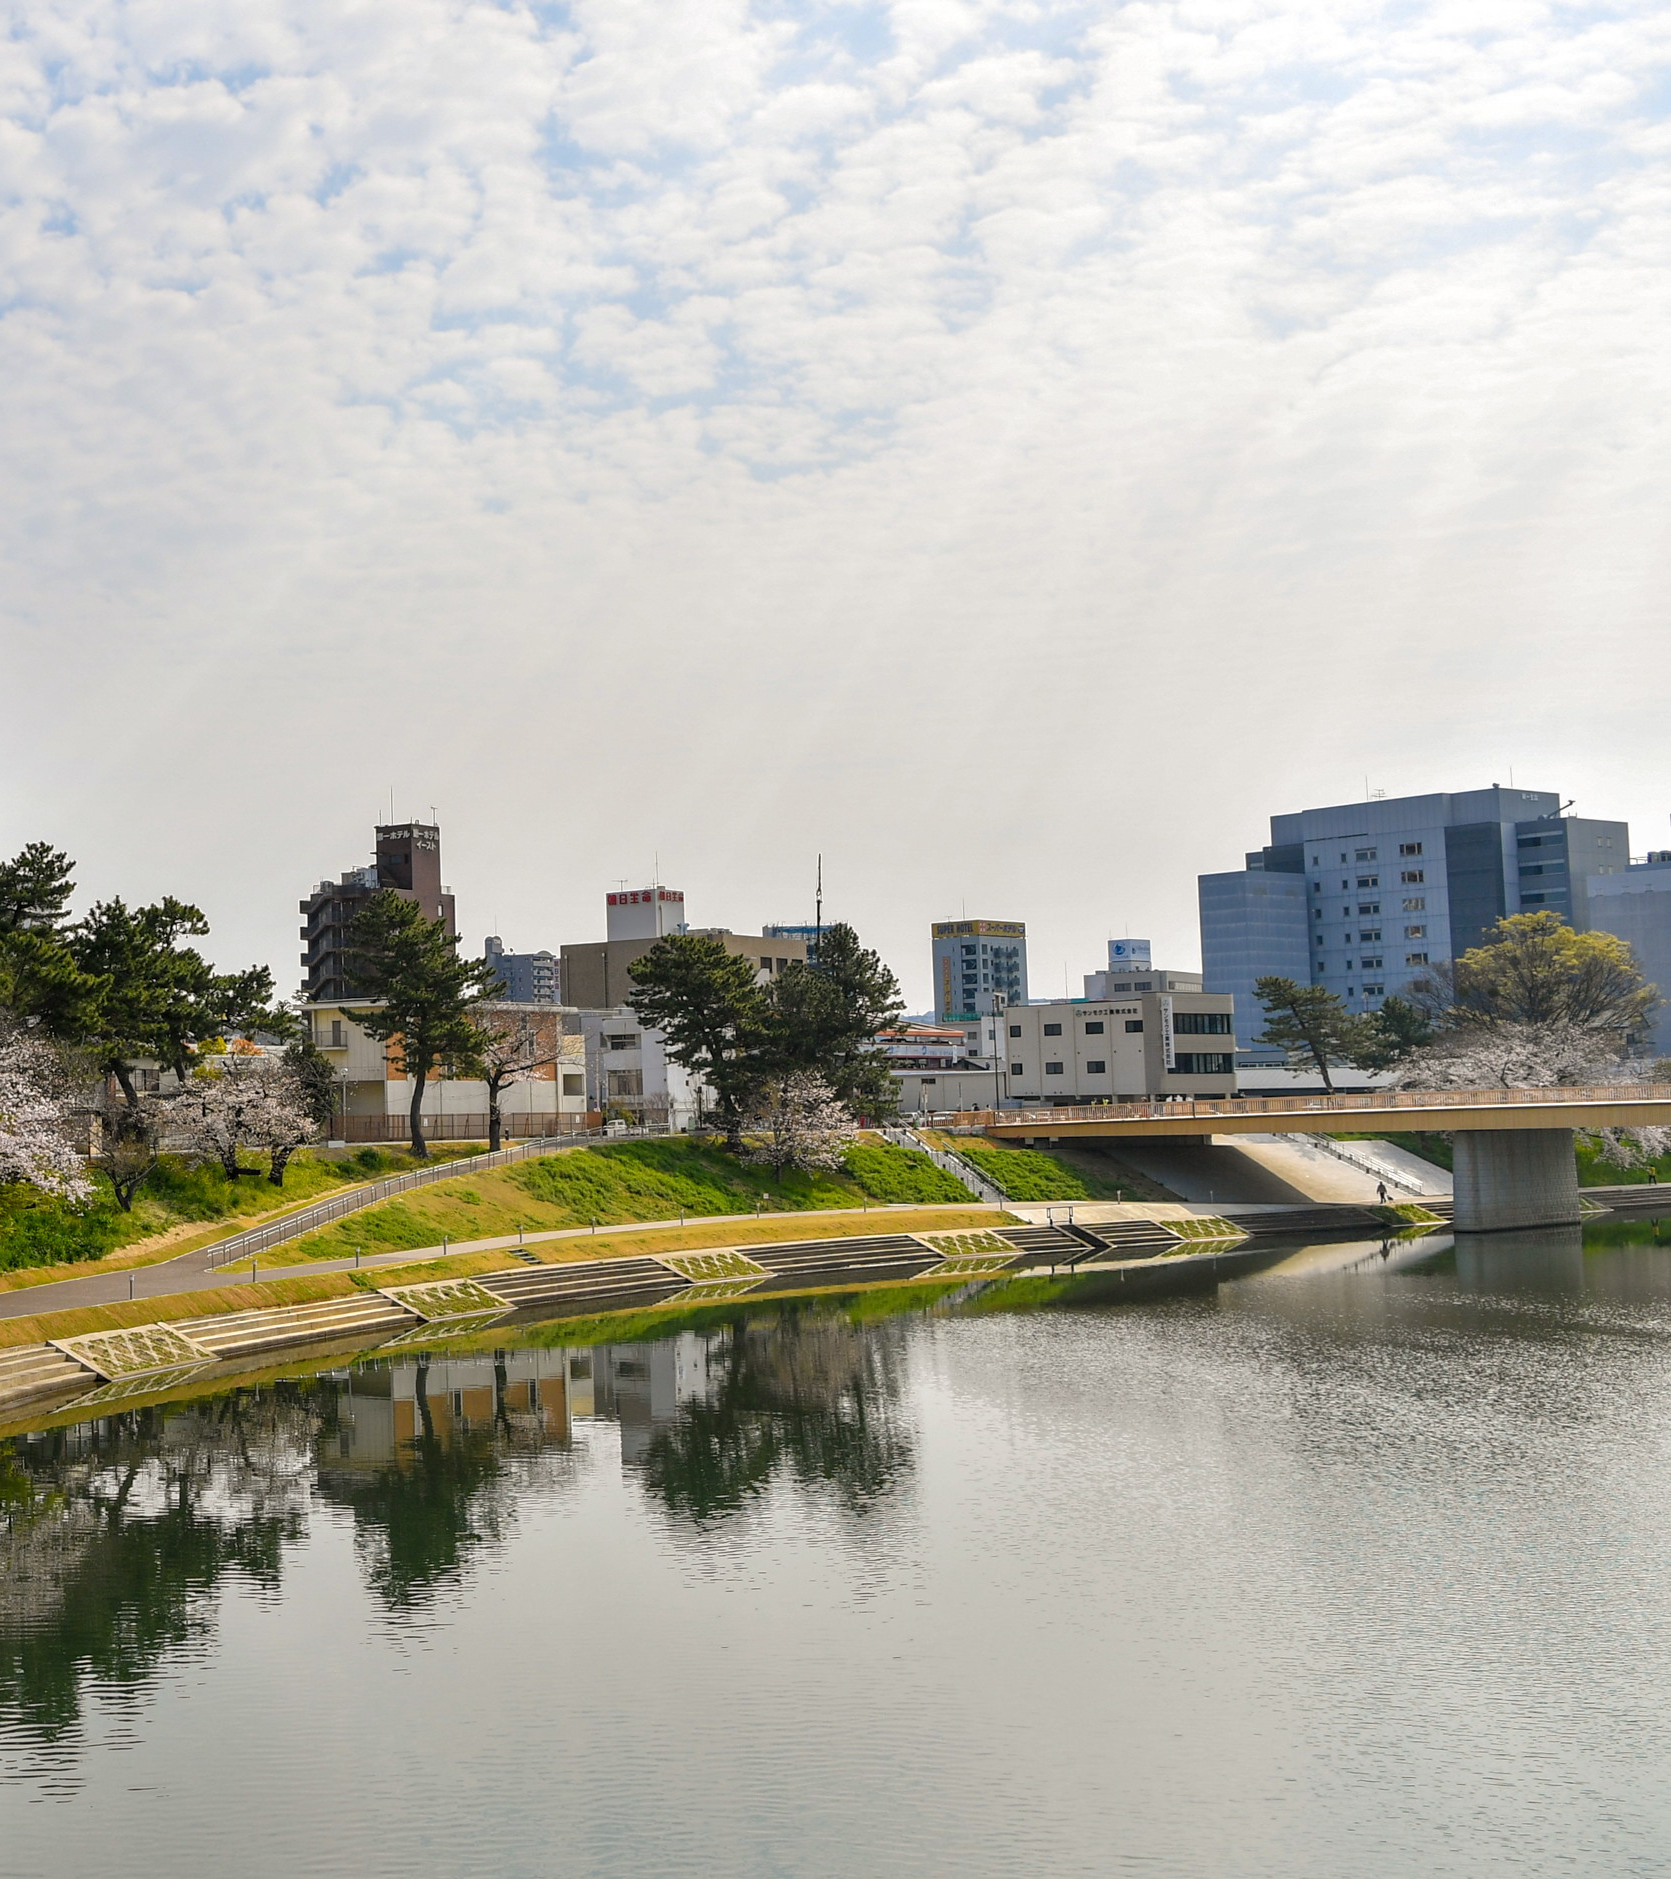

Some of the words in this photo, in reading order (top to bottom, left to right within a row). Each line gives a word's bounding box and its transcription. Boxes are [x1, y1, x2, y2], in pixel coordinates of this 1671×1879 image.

[416, 840, 437, 850] イースト
[659, 890, 684, 903] 日生命
[1082, 1007, 1138, 1016] サンモク工株式会社
[1163, 1007, 1171, 1066] サンモク工式会社
